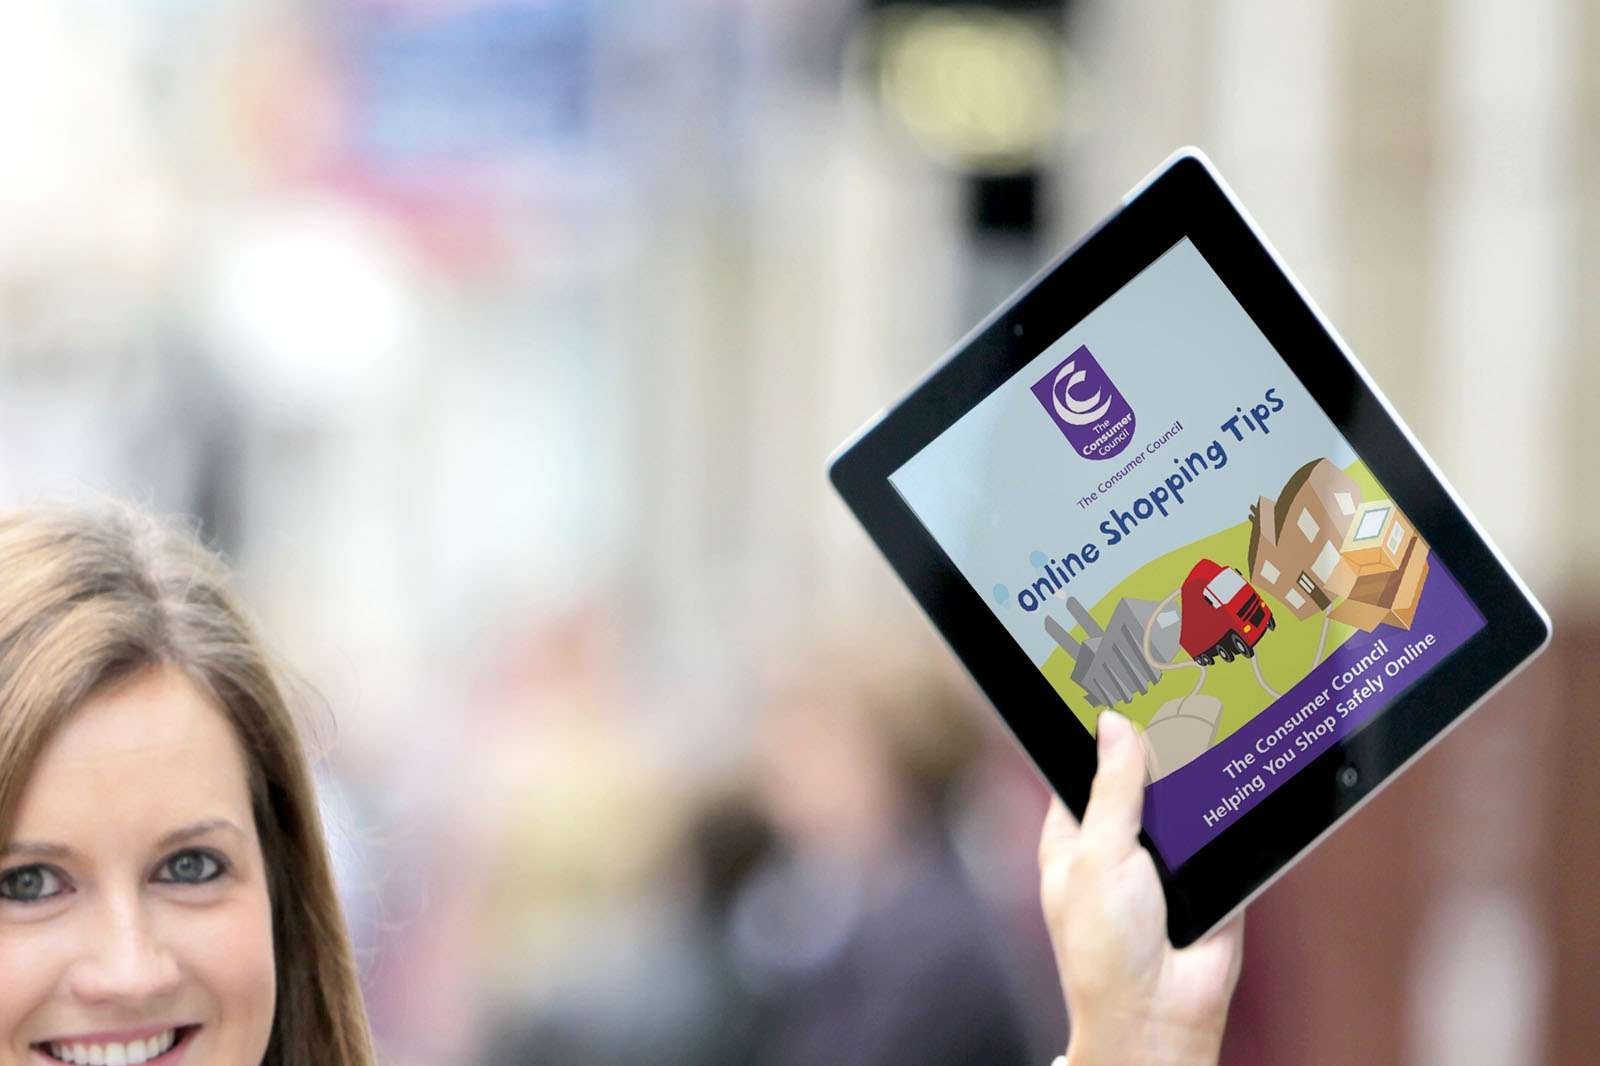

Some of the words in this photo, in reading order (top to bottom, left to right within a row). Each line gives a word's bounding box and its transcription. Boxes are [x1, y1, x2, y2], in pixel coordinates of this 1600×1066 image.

[1082, 412, 1133, 456] Consumer
[1092, 418, 1111, 435] The
[1220, 387, 1284, 442] Tips
[1076, 491, 1098, 510] The
[1097, 452, 1146, 494] Consumer
[1145, 420, 1184, 454] Council
[1098, 430, 1130, 456] Council
[1202, 774, 1266, 828] Helping
[1262, 748, 1297, 776] You
[1294, 715, 1337, 753] Shop
[1335, 674, 1385, 719] Safely
[1384, 632, 1437, 678] Online
[1222, 754, 1256, 779] The
[1254, 688, 1331, 755] Consumer
[1330, 638, 1389, 692] Council
